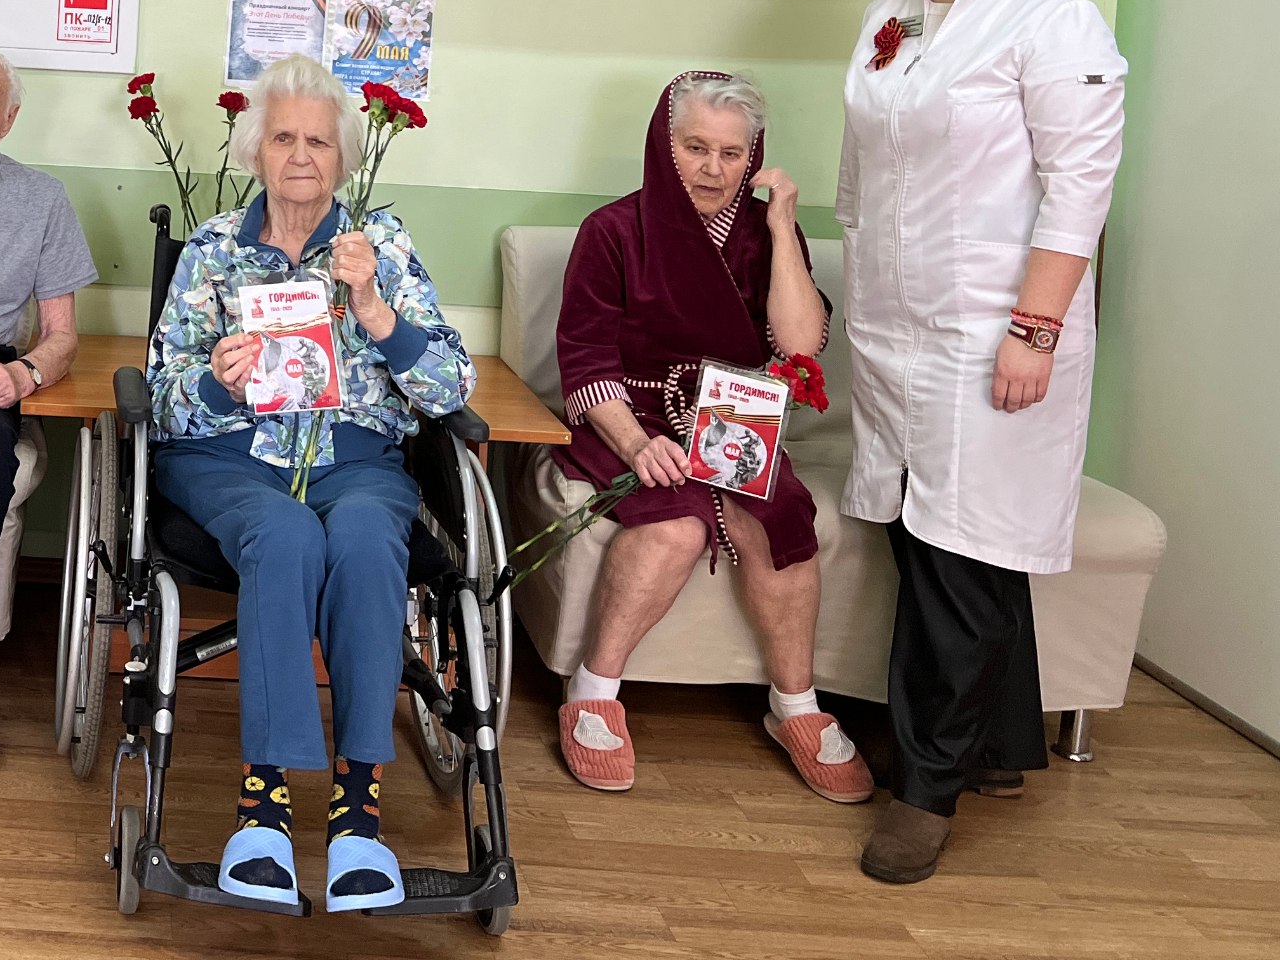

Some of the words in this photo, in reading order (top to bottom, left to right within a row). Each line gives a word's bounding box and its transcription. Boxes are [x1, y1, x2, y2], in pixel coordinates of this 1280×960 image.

[376, 46, 409, 61] МАЯ
[287, 364, 303, 373] МАЯ
[730, 382, 779, 402] ГОРДИМСЯ!
